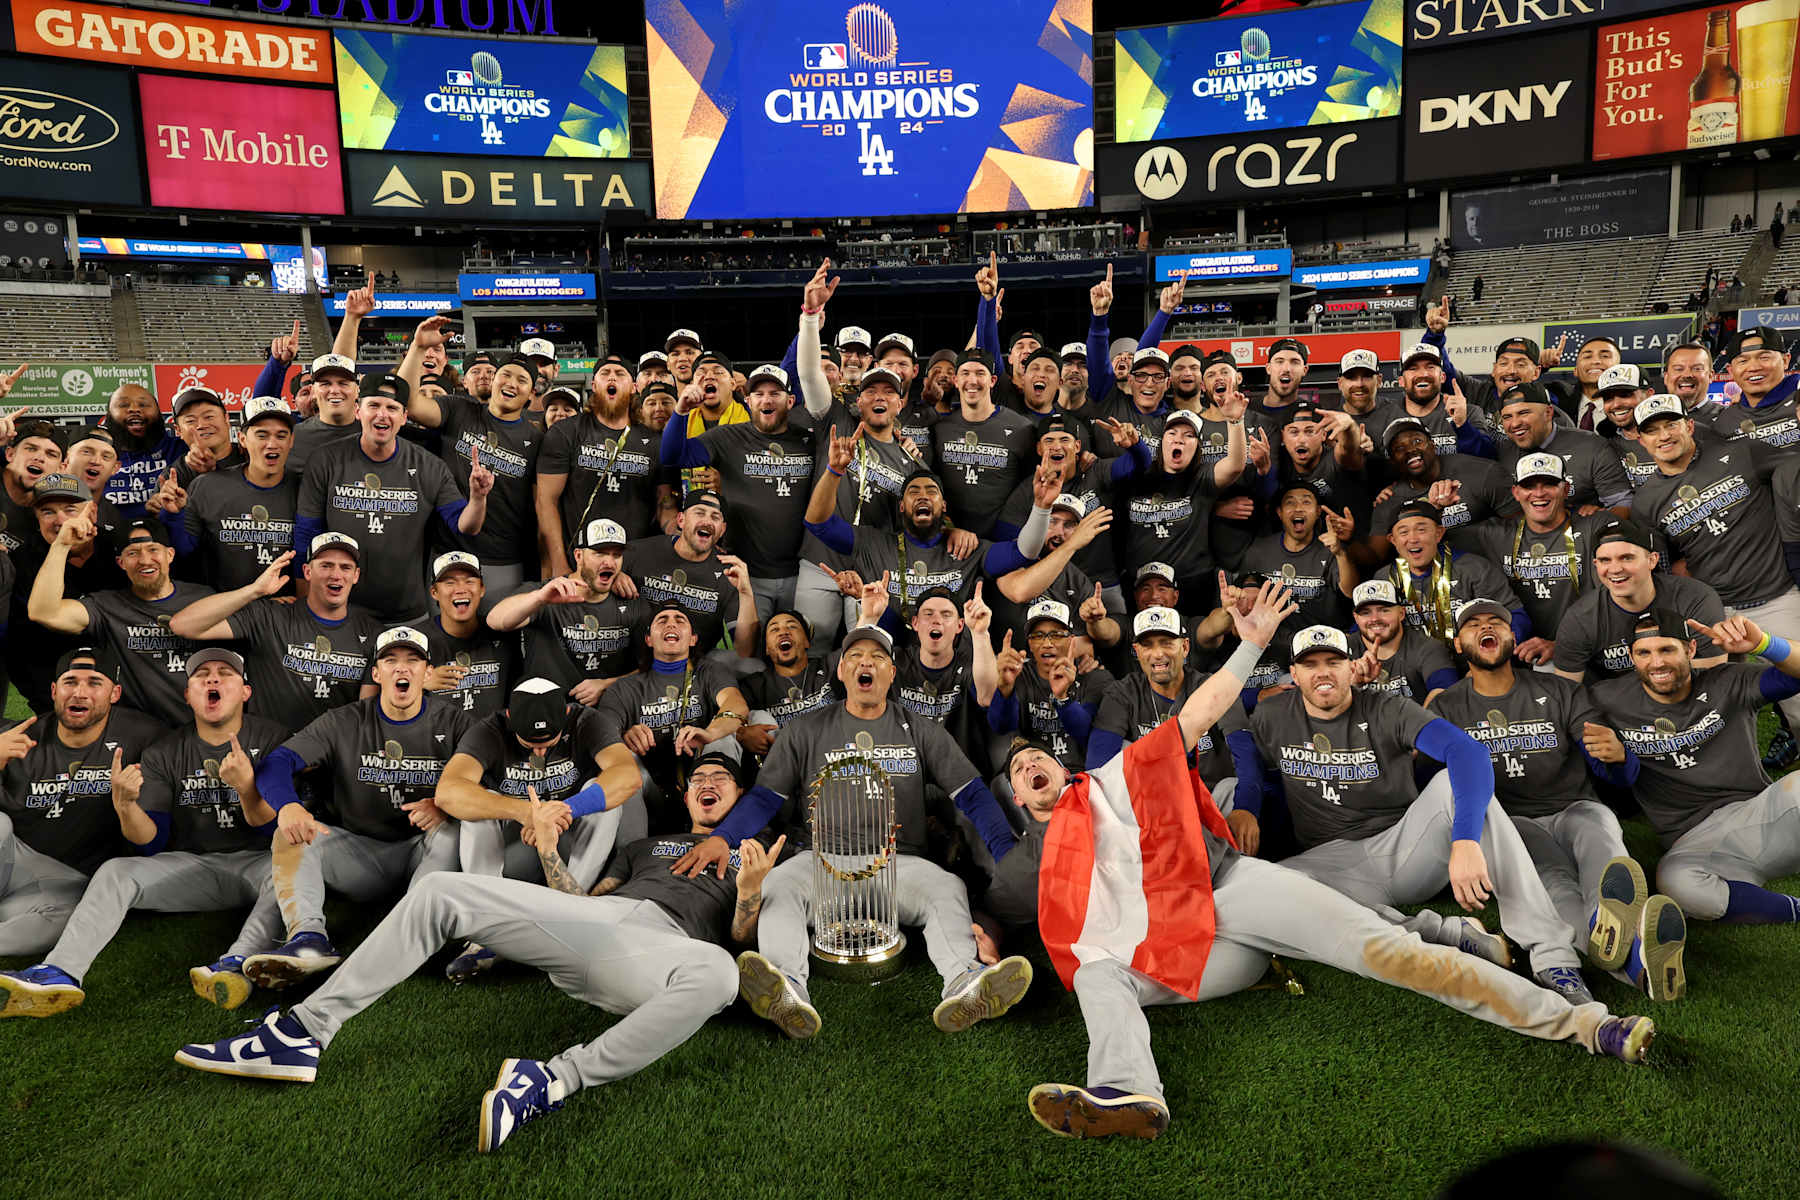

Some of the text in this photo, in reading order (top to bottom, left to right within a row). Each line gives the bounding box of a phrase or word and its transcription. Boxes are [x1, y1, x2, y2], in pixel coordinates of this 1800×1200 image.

[35, 9, 318, 72] GATORADE
[1605, 27, 1671, 55] This
[1207, 58, 1302, 77] WORLD SERIES
[1604, 50, 1683, 79] Bud's
[790, 69, 953, 88] WORLD SERIES
[1192, 65, 1318, 98] CHAMPIONS
[439, 85, 535, 99] WORLD SERIES
[1224, 93, 1239, 102] 20
[1603, 82, 1653, 104] For
[424, 92, 550, 117] CHAMPIONS
[764, 83, 980, 123] CHAMPIONS
[1244, 91, 1266, 121] LA
[1419, 80, 1573, 133] DKNY
[459, 113, 474, 122] 20
[505, 116, 519, 124] 24
[1602, 104, 1664, 127] You.
[480, 115, 503, 144] LA
[822, 123, 845, 136] 20
[900, 121, 924, 134] 24
[200, 128, 329, 168] Mobile
[857, 122, 894, 176] LA
[1208, 133, 1358, 192] razr
[441, 170, 634, 208] DELTA
[1544, 222, 1620, 239] THE BOSS
[1232, 263, 1279, 274] DODGERS
[1321, 271, 1348, 282] WORLD
[1373, 267, 1419, 279] CHAMPIONS
[472, 288, 584, 297] LOS ANGELES DODGERS
[408, 300, 452, 310] CHAMPIONS
[1368, 299, 1415, 310] TERRACE
[92, 366, 148, 378] Workmen's
[1756, 419, 1797, 438] SERIES
[462, 431, 529, 467] WORLD SERIES
[617, 453, 650, 464] SERIES
[944, 442, 1008, 457] WORLD SERIES
[745, 454, 813, 466] WORLD SERIES
[110, 479, 125, 488] 20
[877, 464, 906, 484] SERIES
[965, 464, 979, 484] LA
[335, 486, 418, 501] WORLD SERIES
[776, 477, 791, 497] LA
[333, 495, 418, 513] CHAMPIONS
[1131, 501, 1160, 512] WORLD
[1661, 475, 1745, 525] WORLD SERIES
[1666, 484, 1751, 537] CHAMPIONS
[220, 519, 267, 531] WORLD
[368, 512, 384, 533] LA
[1704, 517, 1729, 536] LA
[257, 543, 273, 565] LA
[927, 570, 962, 585] SERIES
[1294, 578, 1326, 588] SERIES
[644, 576, 720, 601] WORLD SERIES
[1533, 579, 1551, 599] LA
[563, 627, 630, 640] WORLD SERIES
[167, 650, 185, 672] LA
[287, 644, 368, 668] WORLD SERIES
[470, 662, 500, 675] SERIES
[314, 675, 330, 698] LA
[901, 687, 935, 705] WORLD
[1509, 722, 1555, 736] SERIES
[873, 747, 916, 760] SERIES
[1051, 733, 1068, 755] LA
[1280, 746, 1376, 765] WORLD SERIES
[1502, 752, 1525, 778] LA
[1669, 752, 1697, 769] LA
[1280, 759, 1379, 780] CHAMPIONS
[1320, 780, 1342, 805] LA
[214, 804, 235, 829] LA
